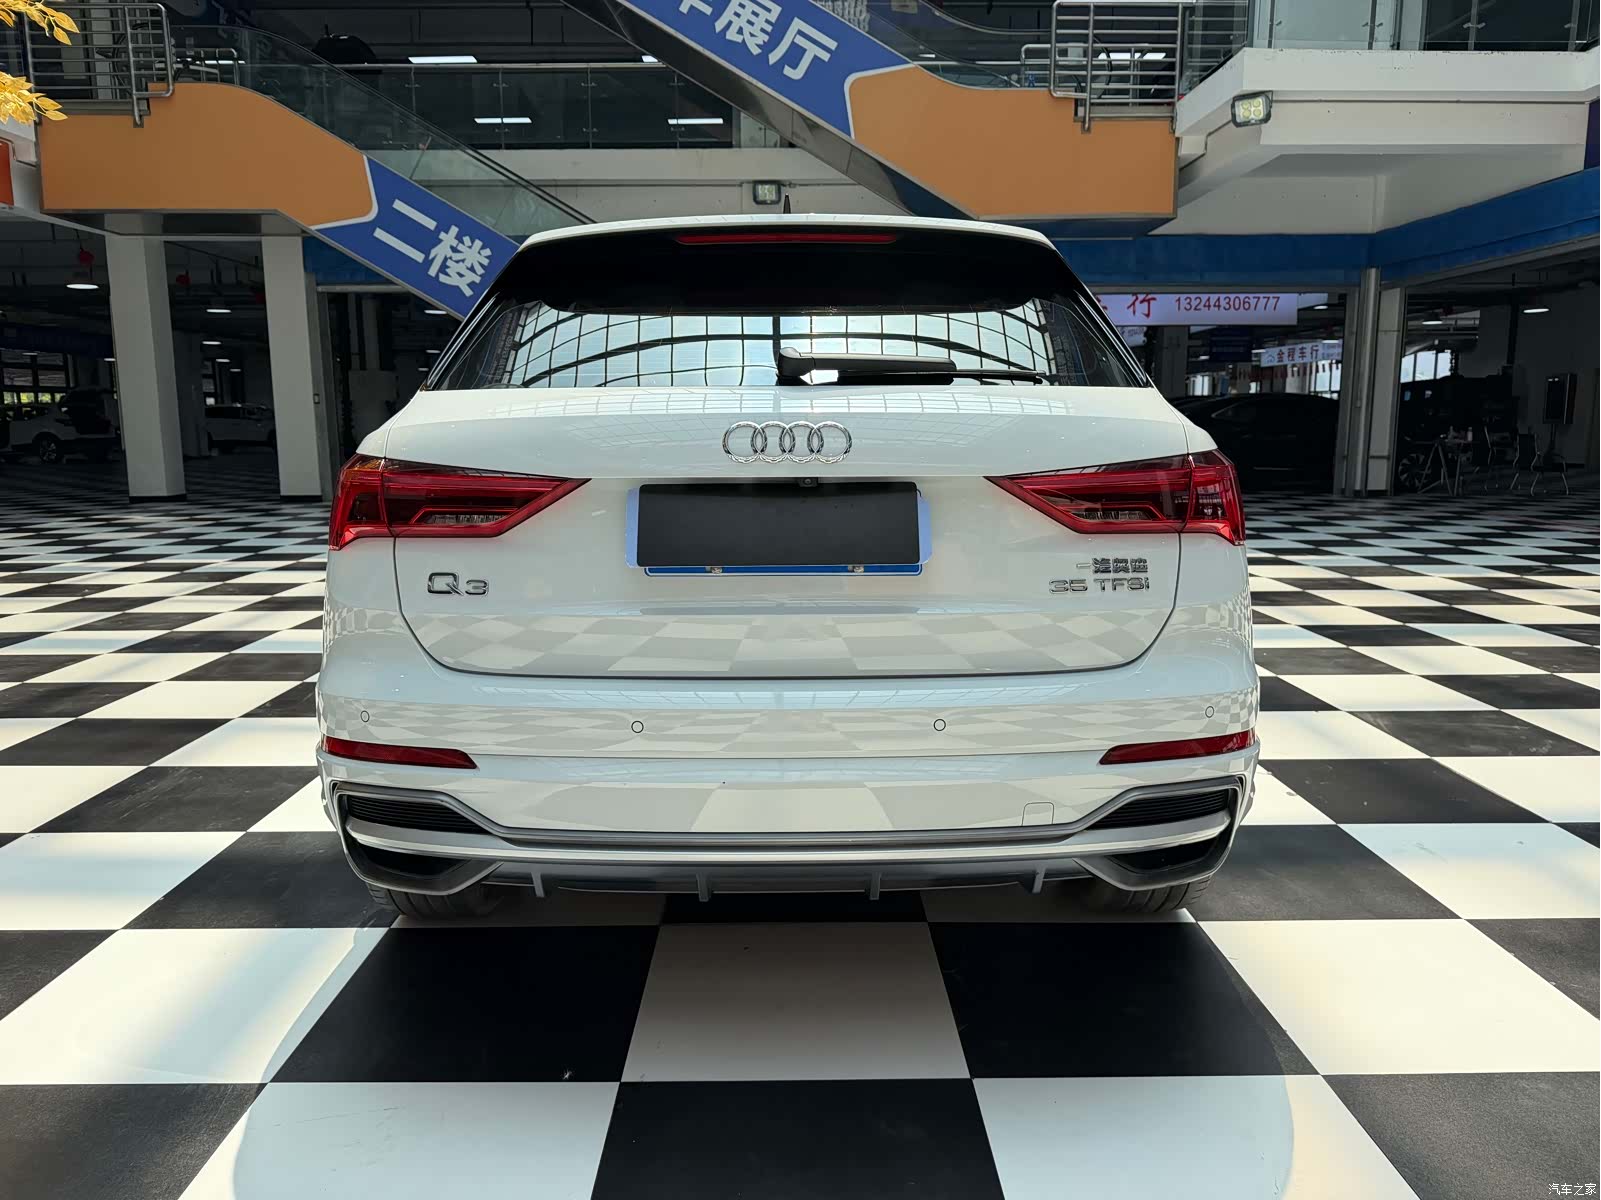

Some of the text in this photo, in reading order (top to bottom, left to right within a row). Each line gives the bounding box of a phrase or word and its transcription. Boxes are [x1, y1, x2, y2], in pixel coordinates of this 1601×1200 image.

[373, 199, 492, 297] 二楼
[1175, 295, 1281, 312] 13244306777
[427, 572, 489, 596] Q3
[1049, 579, 1088, 594] 35
